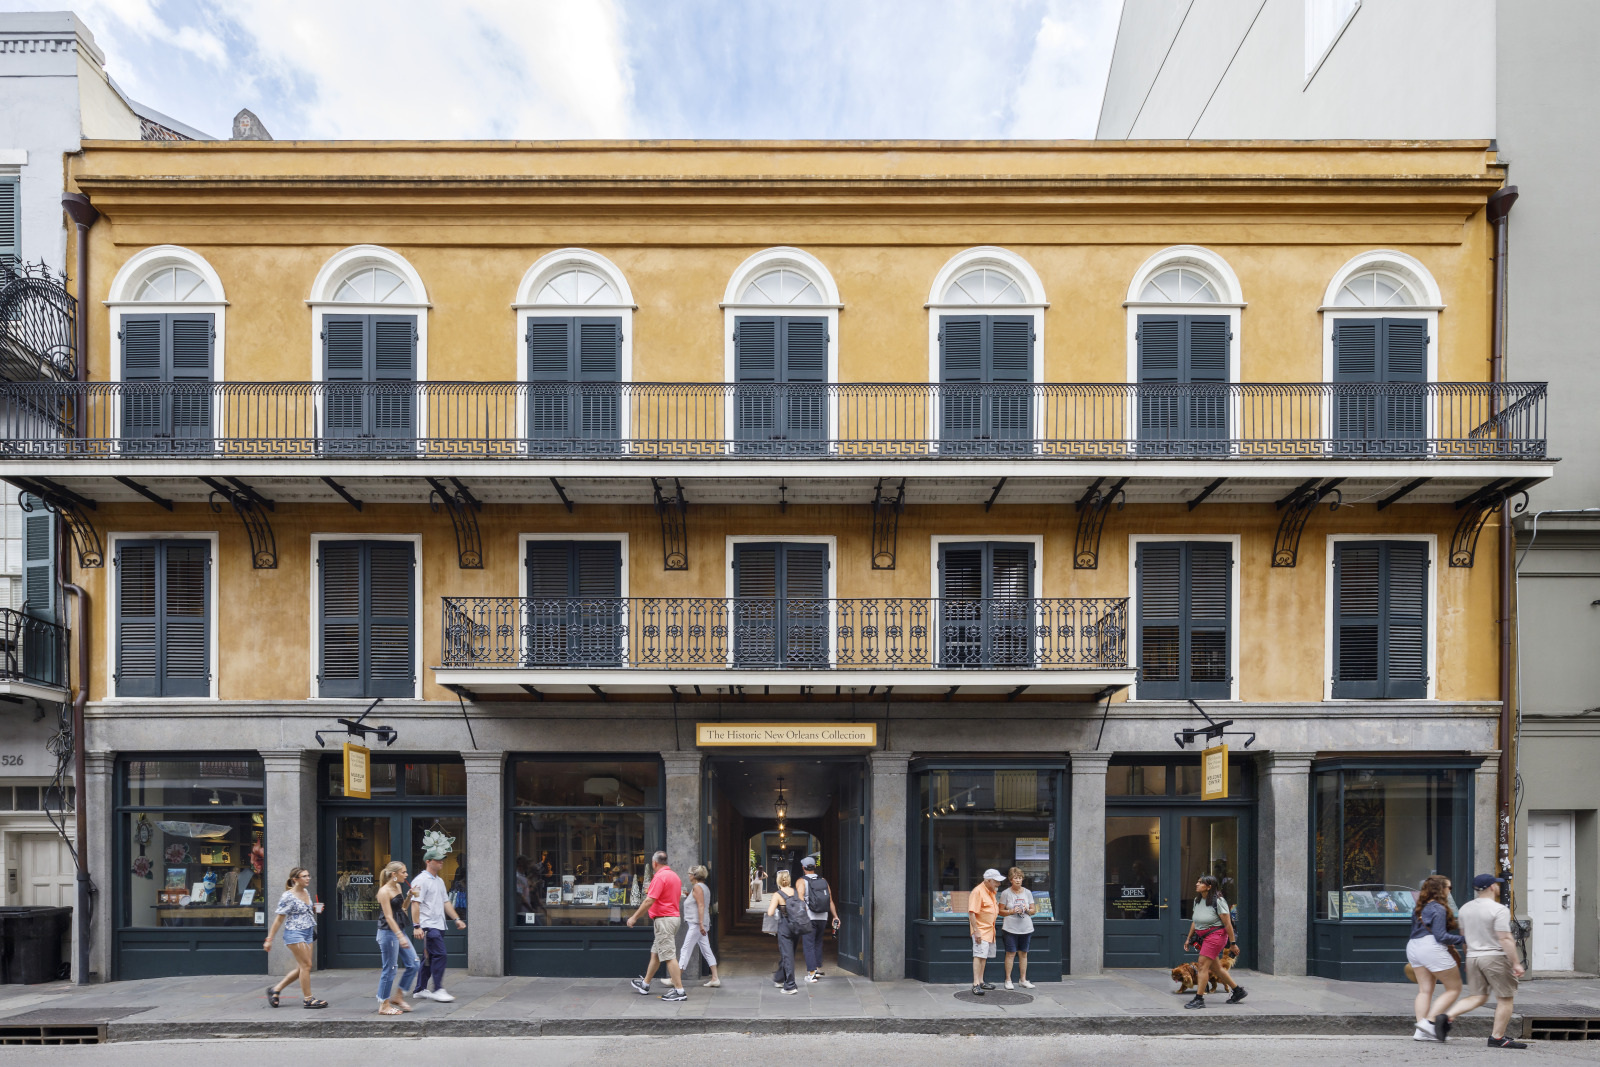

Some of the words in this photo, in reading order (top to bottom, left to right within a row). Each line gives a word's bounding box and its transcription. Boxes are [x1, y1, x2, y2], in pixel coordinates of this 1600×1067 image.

[707, 730, 725, 740] The
[727, 730, 762, 740] Historic
[764, 730, 784, 740] New
[786, 730, 819, 740] Orleans
[821, 730, 866, 740] Collection
[1, 754, 24, 766] 526
